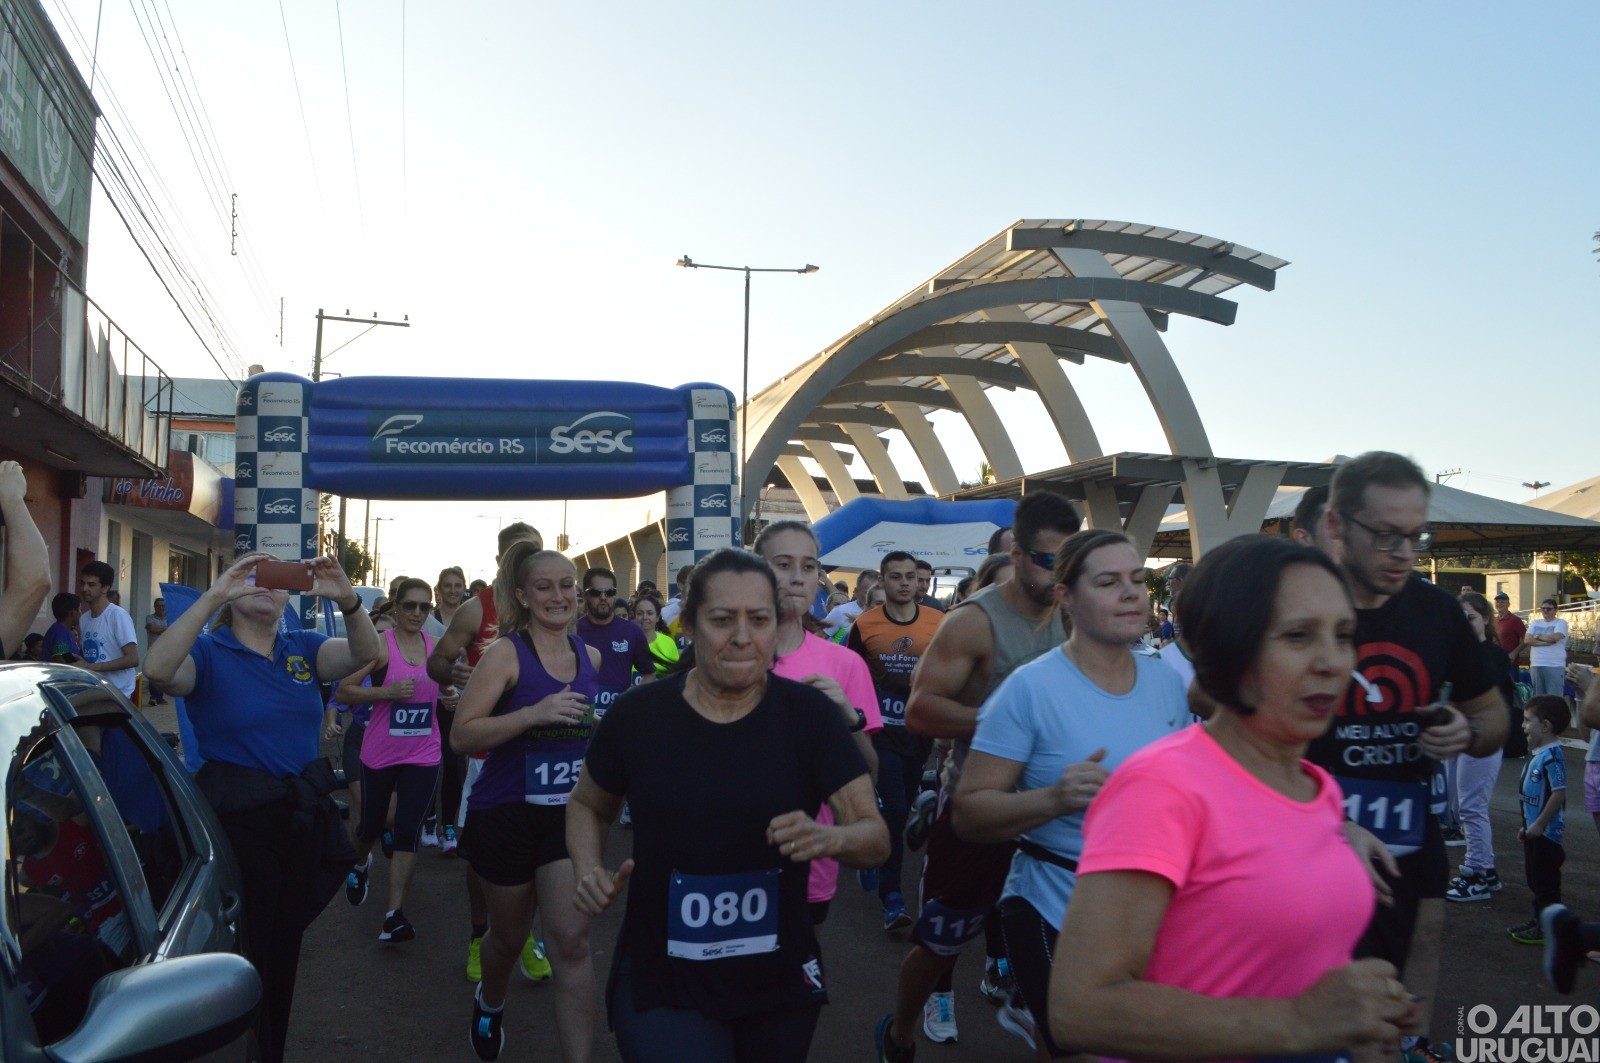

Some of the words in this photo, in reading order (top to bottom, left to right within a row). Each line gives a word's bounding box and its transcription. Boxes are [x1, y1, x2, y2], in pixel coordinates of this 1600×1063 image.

[264, 429, 296, 442] Sesc
[549, 417, 633, 454] Sesc
[700, 431, 727, 443] Sesc
[385, 438, 494, 454] Fecomércio
[499, 438, 525, 454] RS
[140, 477, 185, 505] Vinho
[264, 501, 296, 514] Sesc
[700, 497, 728, 508] Sesc
[669, 531, 689, 543] Sesc
[963, 546, 989, 556] Se
[882, 697, 905, 715] 10
[395, 708, 429, 724] 077
[1336, 725, 1370, 739] MEU
[1374, 722, 1418, 738] ALVO
[1343, 743, 1424, 767] CRISTO
[535, 759, 584, 786] 125
[1341, 793, 1414, 831] 111
[680, 887, 769, 928] 080
